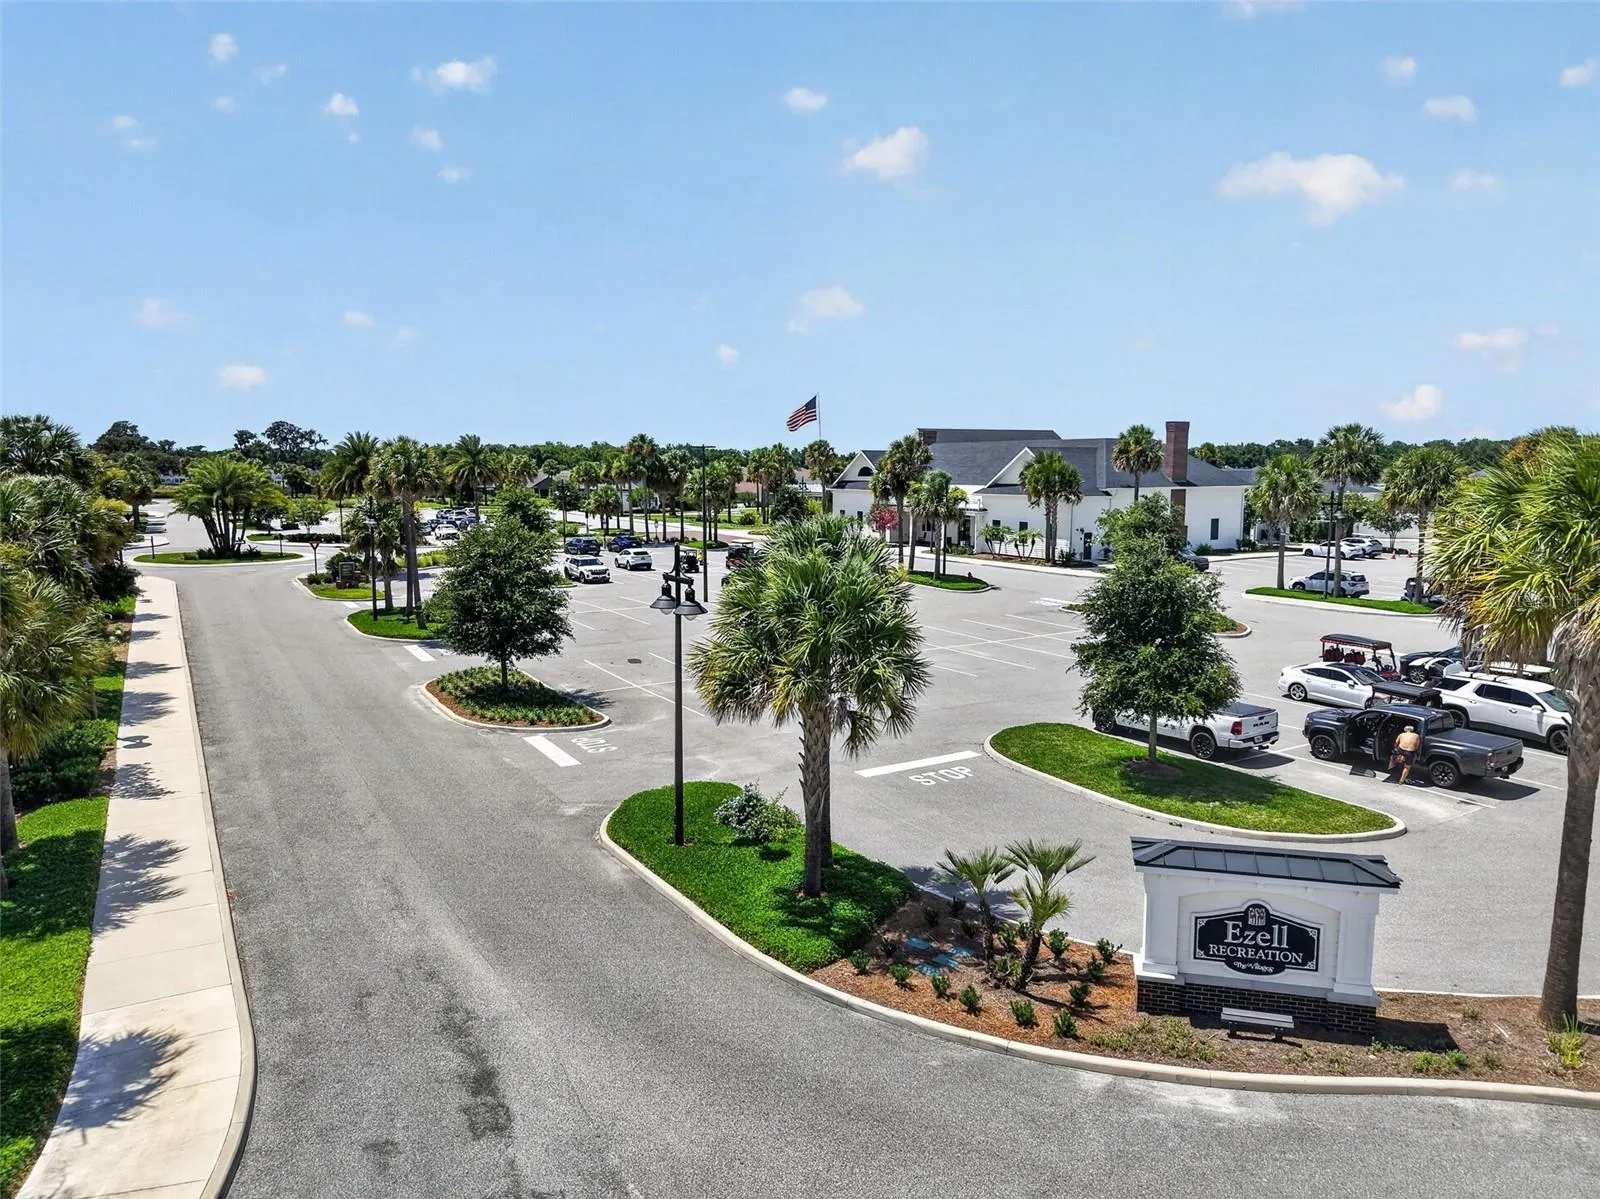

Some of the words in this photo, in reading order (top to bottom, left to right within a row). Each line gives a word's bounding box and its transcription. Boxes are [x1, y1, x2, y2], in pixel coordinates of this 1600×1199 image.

[908, 766, 974, 786] STOP
[1224, 920, 1289, 949] Ezell
[1208, 943, 1304, 964] RECREATION
